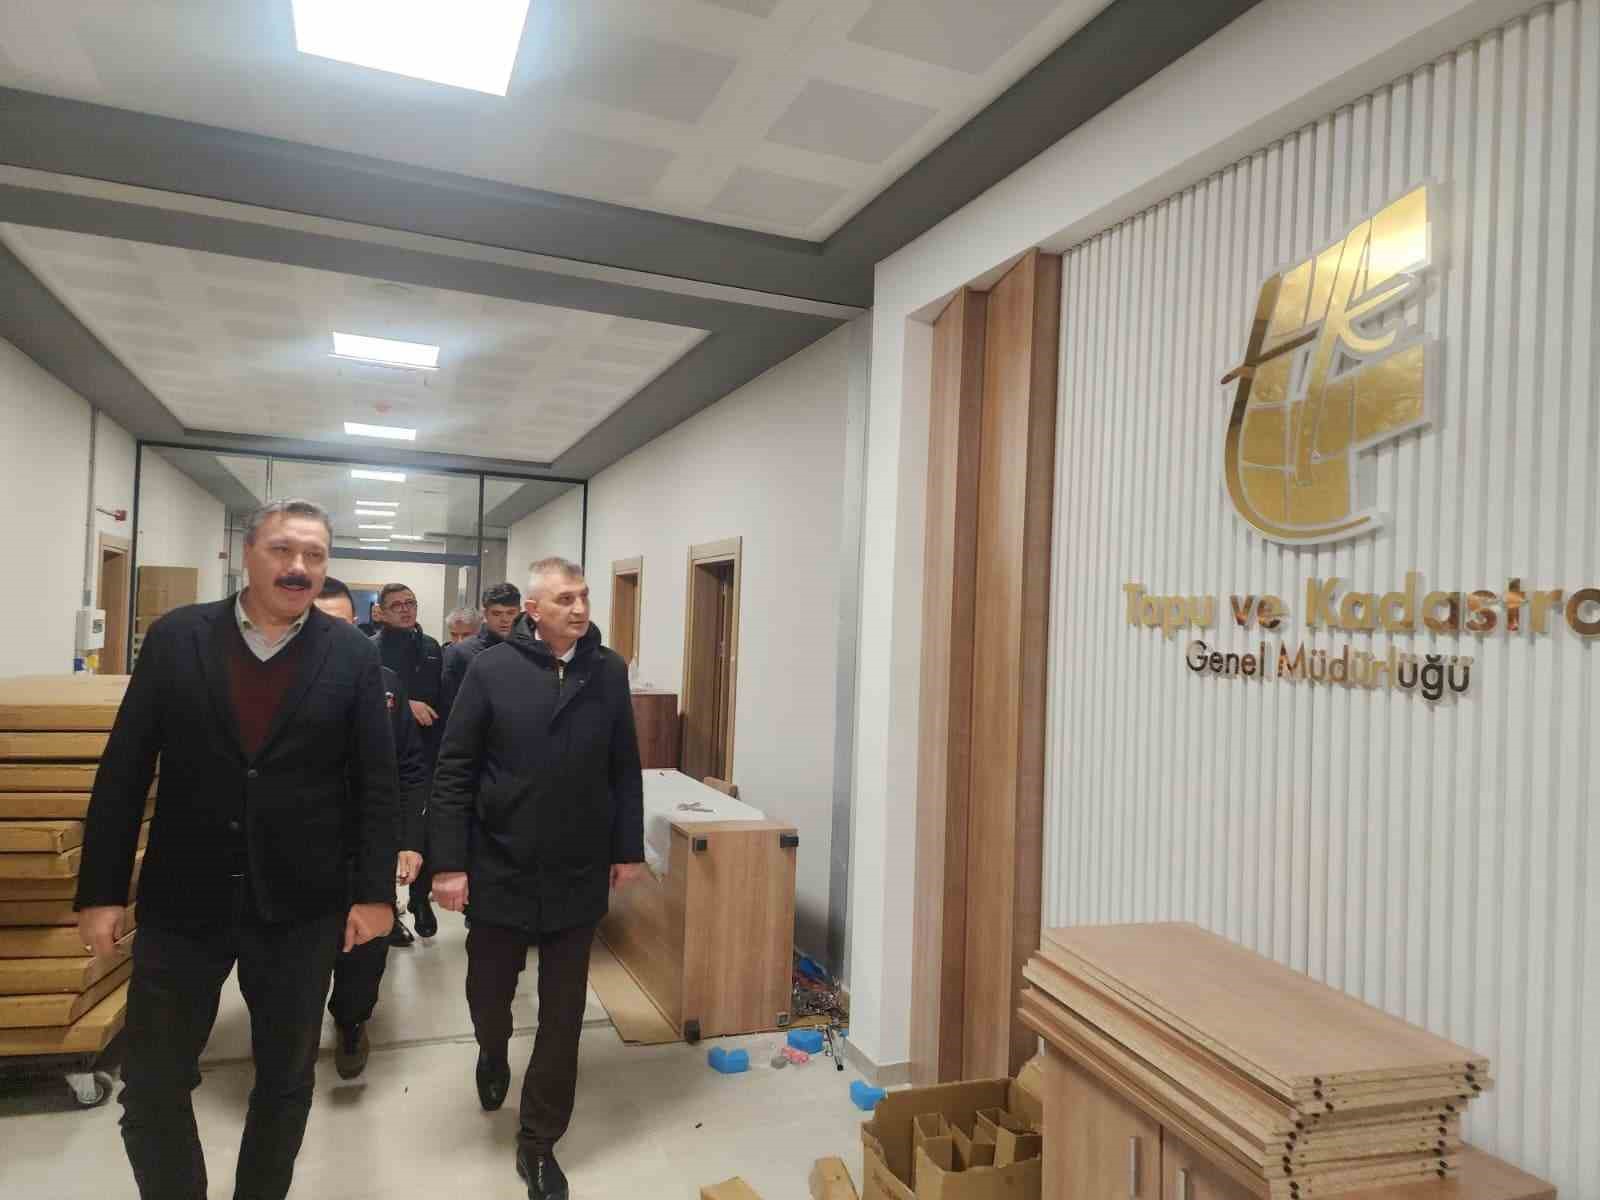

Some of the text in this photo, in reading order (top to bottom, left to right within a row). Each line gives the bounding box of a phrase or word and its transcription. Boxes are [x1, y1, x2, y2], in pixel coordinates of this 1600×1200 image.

[1123, 572, 1600, 638] Tapu ve Kadastro
[1186, 640, 1472, 700] Genel Müdürlüğü
